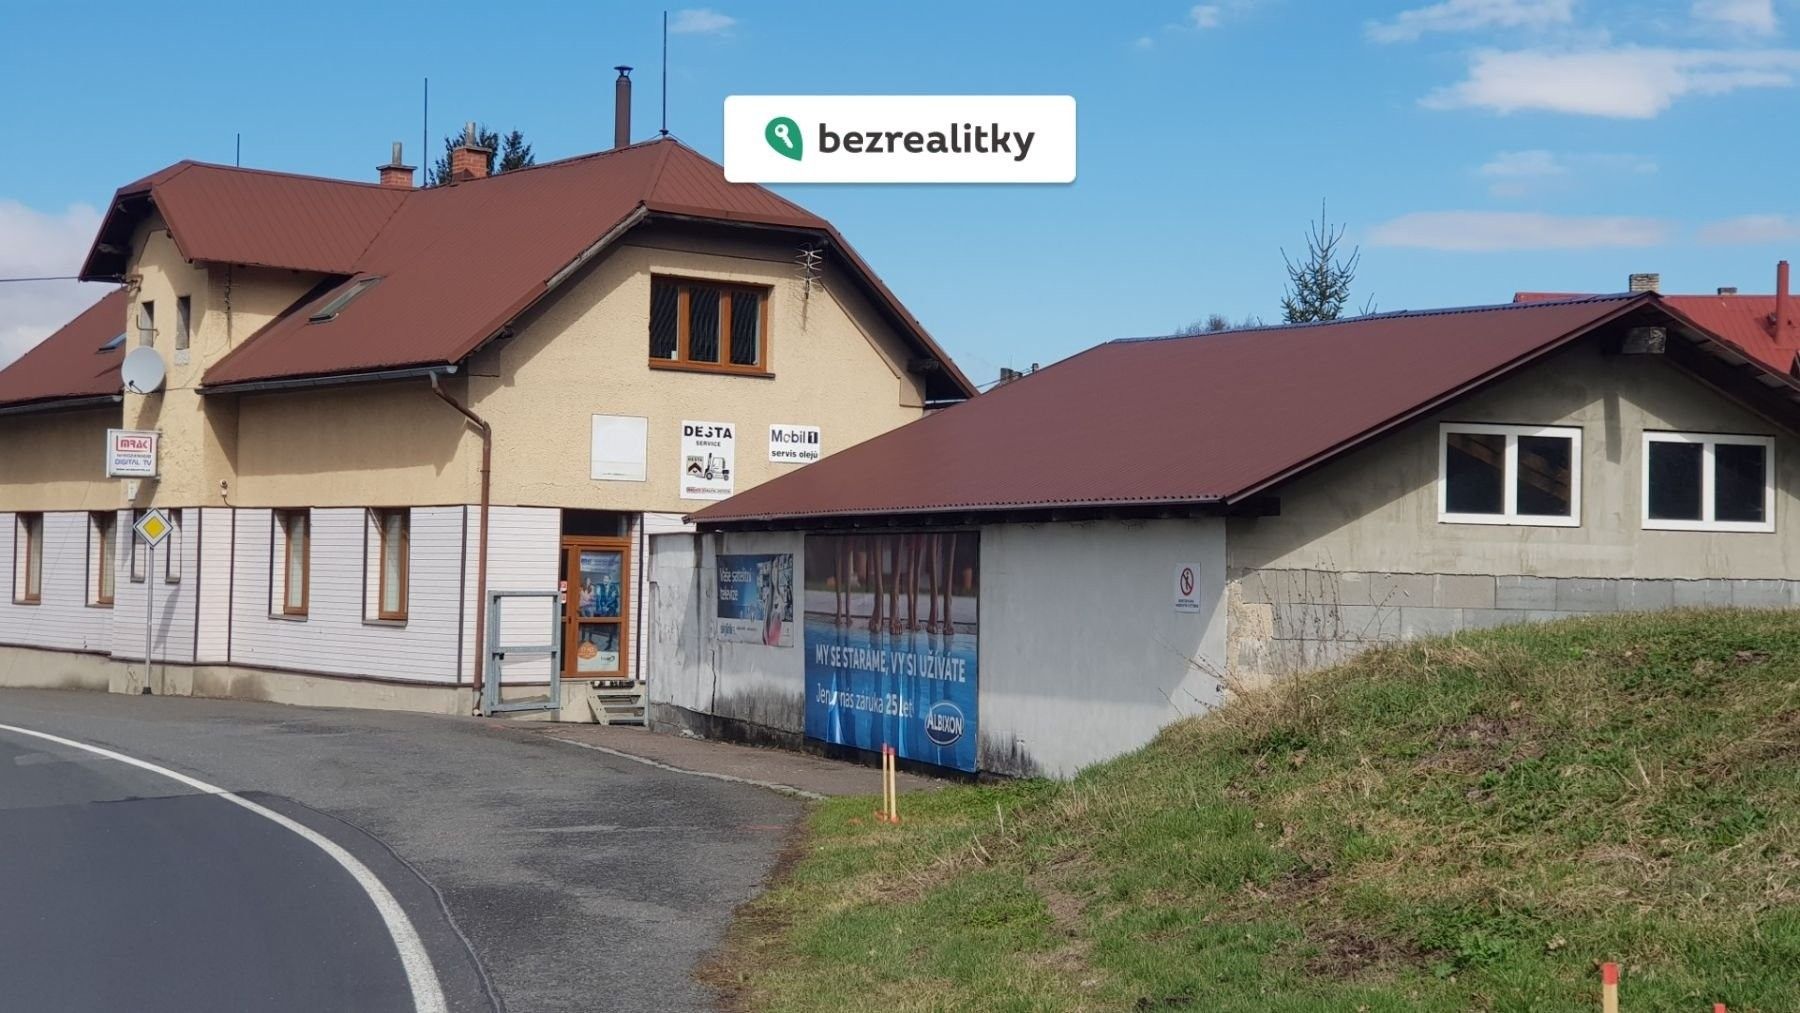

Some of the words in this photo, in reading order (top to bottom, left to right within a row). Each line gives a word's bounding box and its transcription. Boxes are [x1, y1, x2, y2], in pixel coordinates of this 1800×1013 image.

[684, 425, 732, 439] DESTA
[771, 429, 806, 444] Mobil
[807, 431, 818, 444] 1
[771, 450, 797, 458] servis
[815, 643, 829, 666] MY
[830, 645, 842, 668] SE
[842, 643, 889, 676] STARÁME,
[890, 651, 905, 675] VY
[906, 653, 917, 677] SI
[919, 649, 966, 683] UŽÍVÁTE
[815, 682, 831, 705] Jen
[840, 687, 854, 709] nás
[855, 690, 884, 714] záruka
[886, 692, 898, 716] 25
[927, 707, 962, 736] ALBIXON
